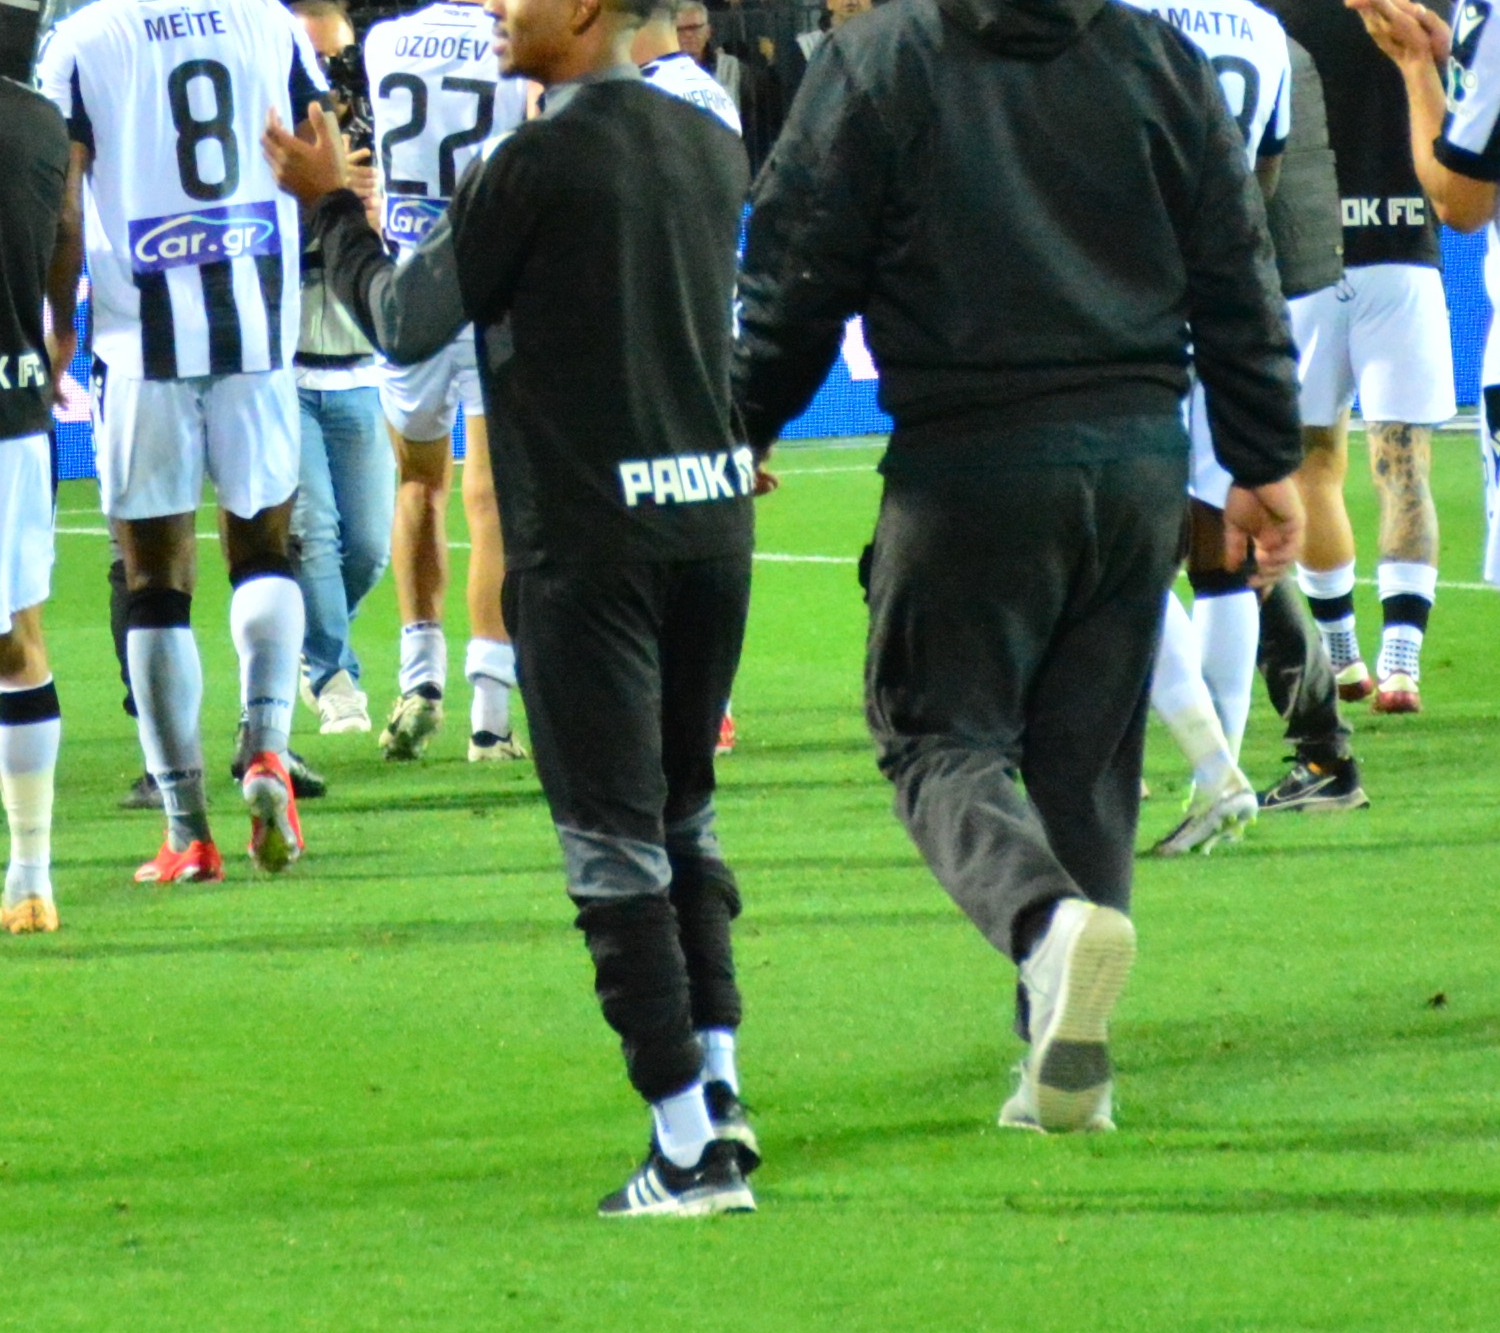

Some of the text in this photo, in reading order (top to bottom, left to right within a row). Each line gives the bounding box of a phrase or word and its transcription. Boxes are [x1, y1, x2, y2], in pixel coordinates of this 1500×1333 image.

[143, 6, 227, 42] MEÏTE
[394, 35, 490, 62] OZDOEV
[167, 58, 241, 202] 8
[378, 71, 499, 197] 27
[1386, 196, 1425, 226] FC
[619, 452, 736, 507] PAOK
